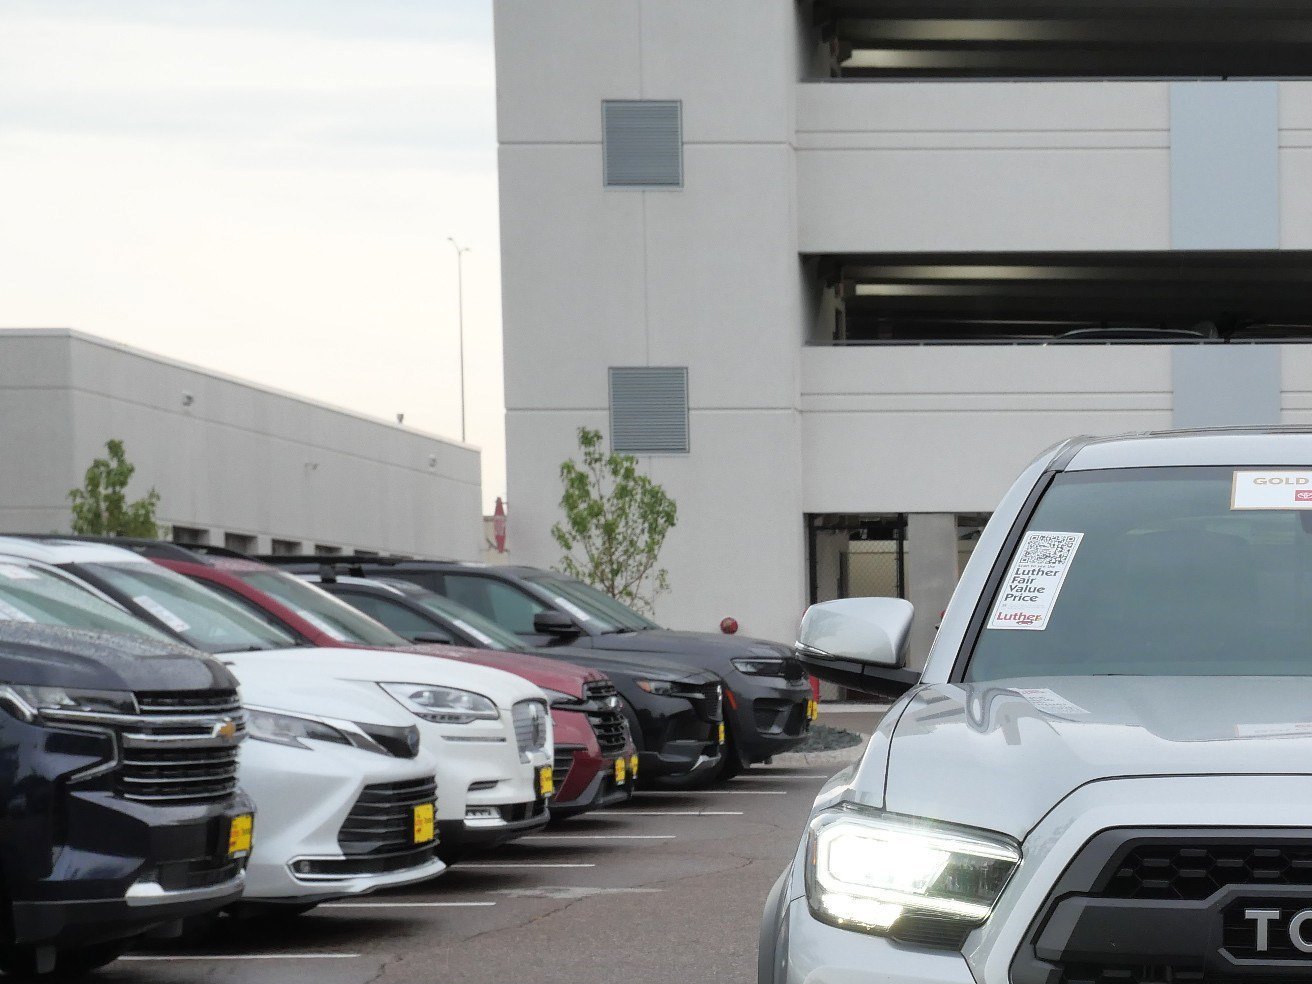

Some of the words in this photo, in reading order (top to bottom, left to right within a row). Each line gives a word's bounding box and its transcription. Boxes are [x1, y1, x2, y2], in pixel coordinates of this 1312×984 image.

[1252, 477, 1310, 486] GOLD
[1014, 567, 1060, 577] Luther
[1011, 575, 1036, 585] Fair
[1009, 584, 1046, 594] Value
[1004, 593, 1039, 602] Price
[996, 612, 1043, 621] Luther
